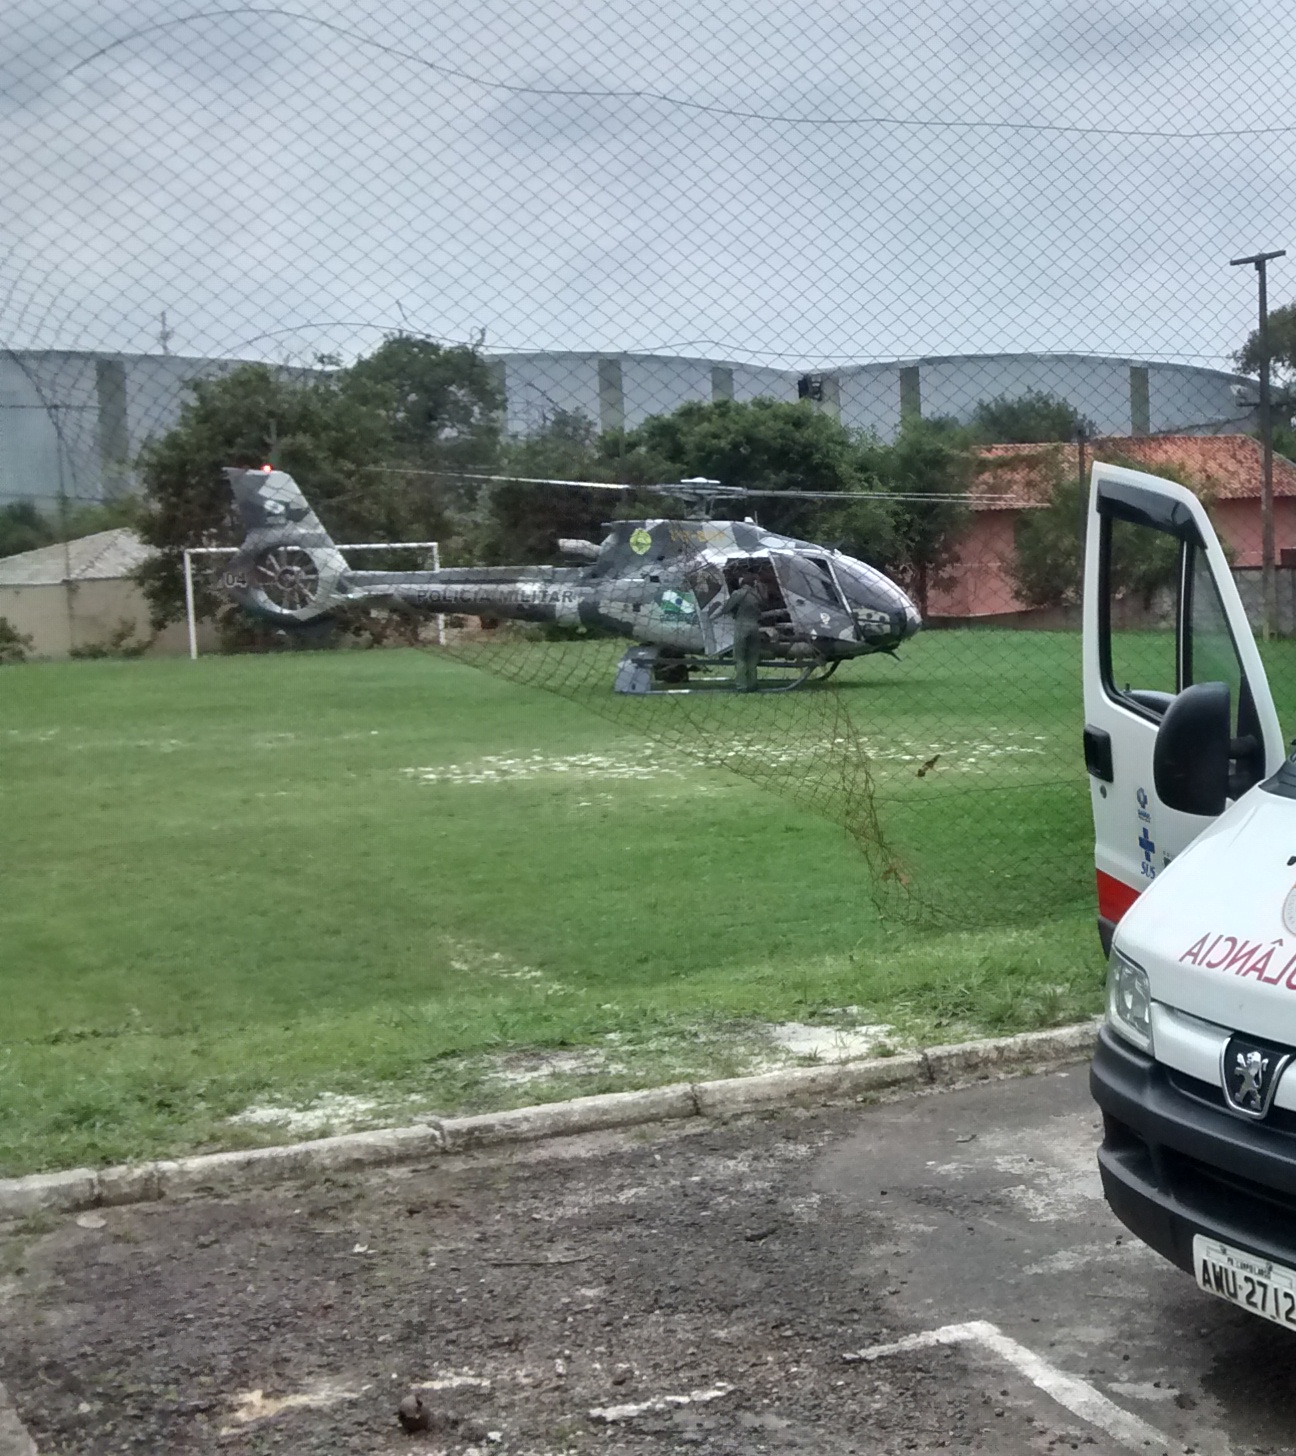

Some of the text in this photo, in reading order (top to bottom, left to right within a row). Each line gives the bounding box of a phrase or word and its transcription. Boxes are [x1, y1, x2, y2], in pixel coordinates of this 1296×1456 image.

[224, 572, 248, 588] 04
[499, 589, 574, 604] MILITAR
[1140, 861, 1156, 879] SUS
